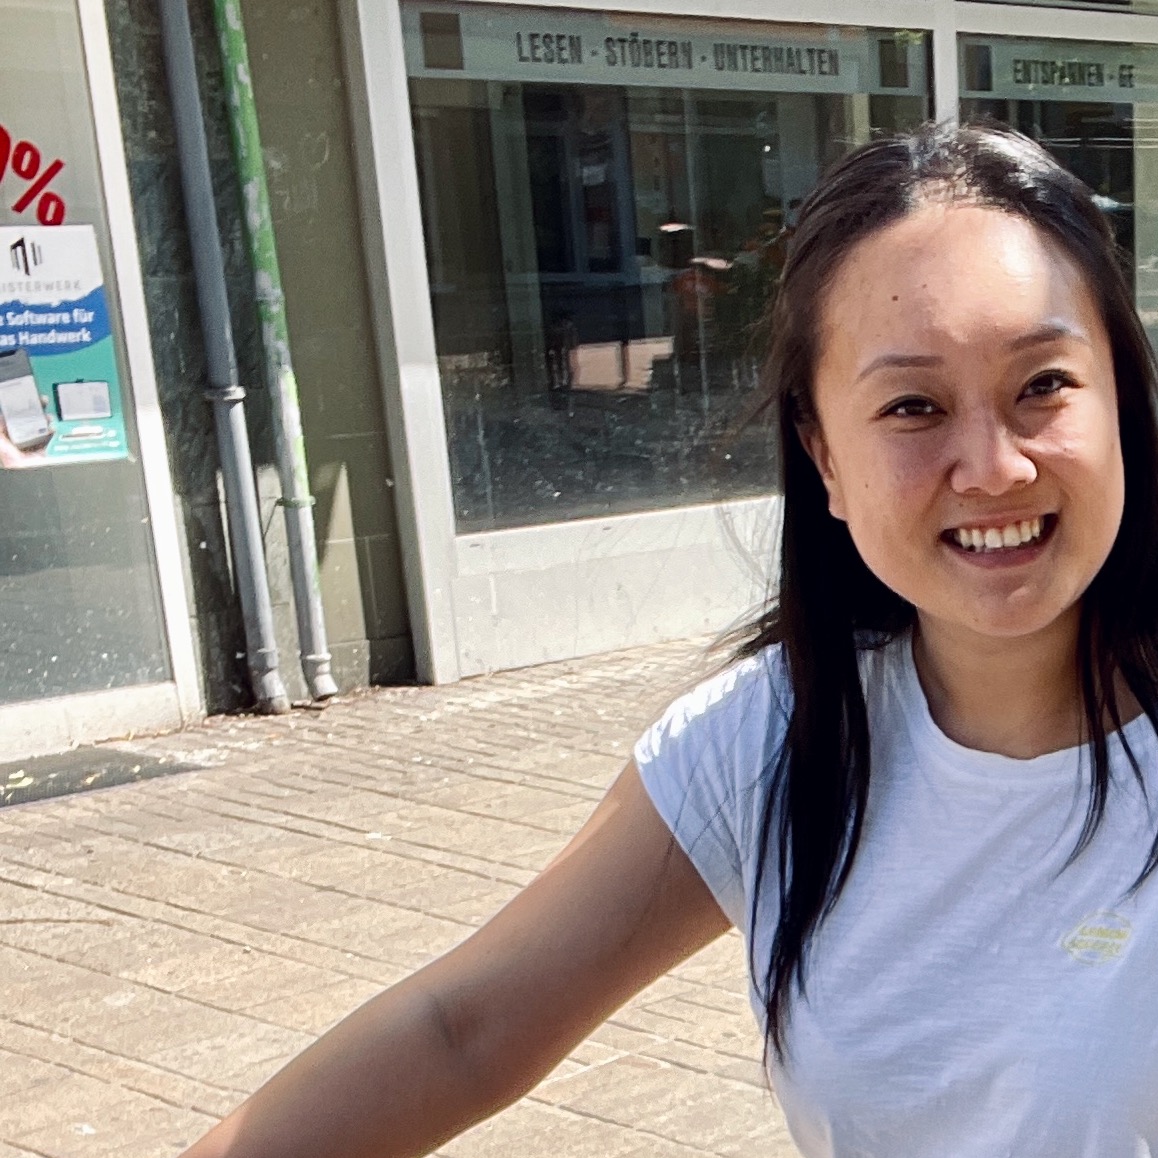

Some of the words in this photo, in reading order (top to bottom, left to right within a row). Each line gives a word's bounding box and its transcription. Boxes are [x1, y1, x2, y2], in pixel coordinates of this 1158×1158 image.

[515, 31, 583, 64] LESEN
[603, 32, 693, 70] STÖBERN
[713, 42, 840, 76] UNTERHALTEN
[1013, 58, 1104, 87] ENTSPANNEN
[6, 309, 71, 325] Software
[72, 308, 95, 323] für
[18, 327, 92, 345] Handwerk
